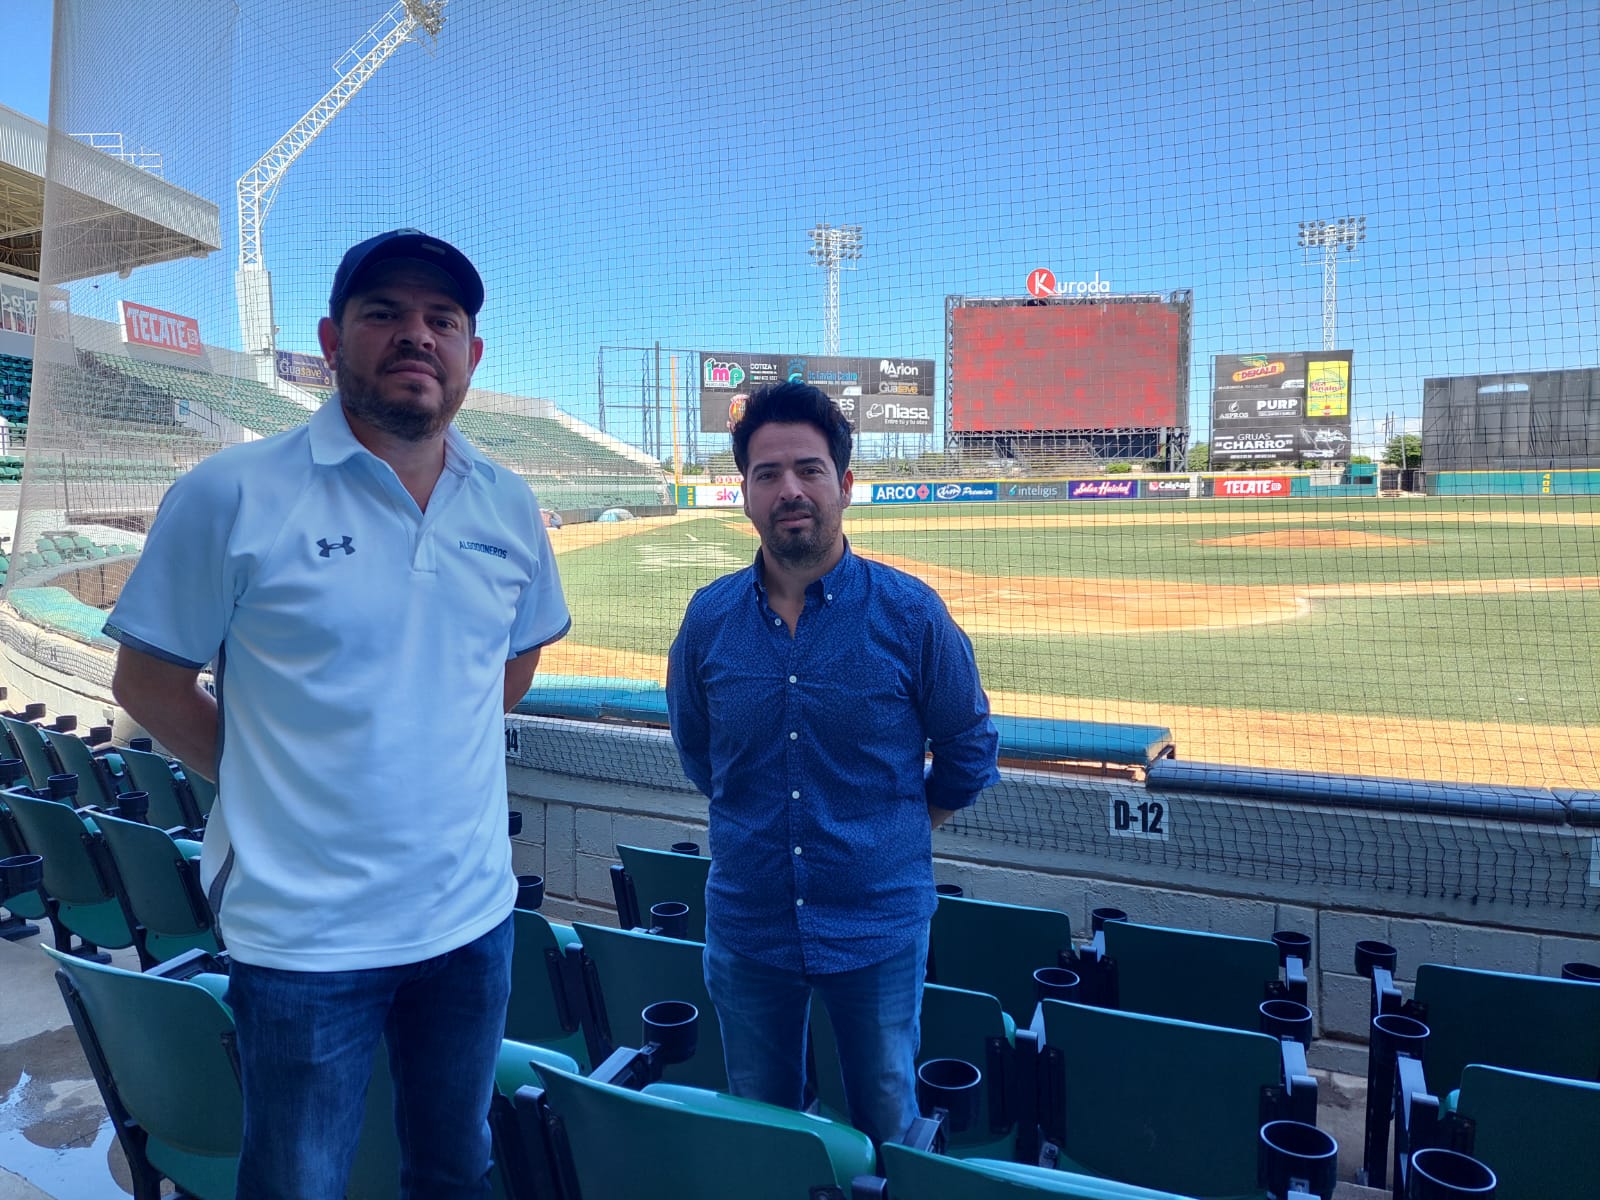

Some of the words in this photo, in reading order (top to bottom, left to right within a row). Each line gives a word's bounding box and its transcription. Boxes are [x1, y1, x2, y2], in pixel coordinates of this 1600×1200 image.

[1033, 270, 1110, 296] Kuroda
[127, 307, 188, 348] TECATE
[280, 359, 321, 377] Guasave
[887, 361, 919, 376] Arion
[1241, 365, 1277, 379] DEKALB
[1257, 399, 1298, 410] PURP
[1237, 432, 1271, 441] GRUAS
[876, 487, 916, 500] ARCO
[1018, 484, 1058, 498] inteligis
[1224, 480, 1272, 494] TECATE
[716, 487, 739, 503] sky
[1114, 799, 1164, 834] D-12
